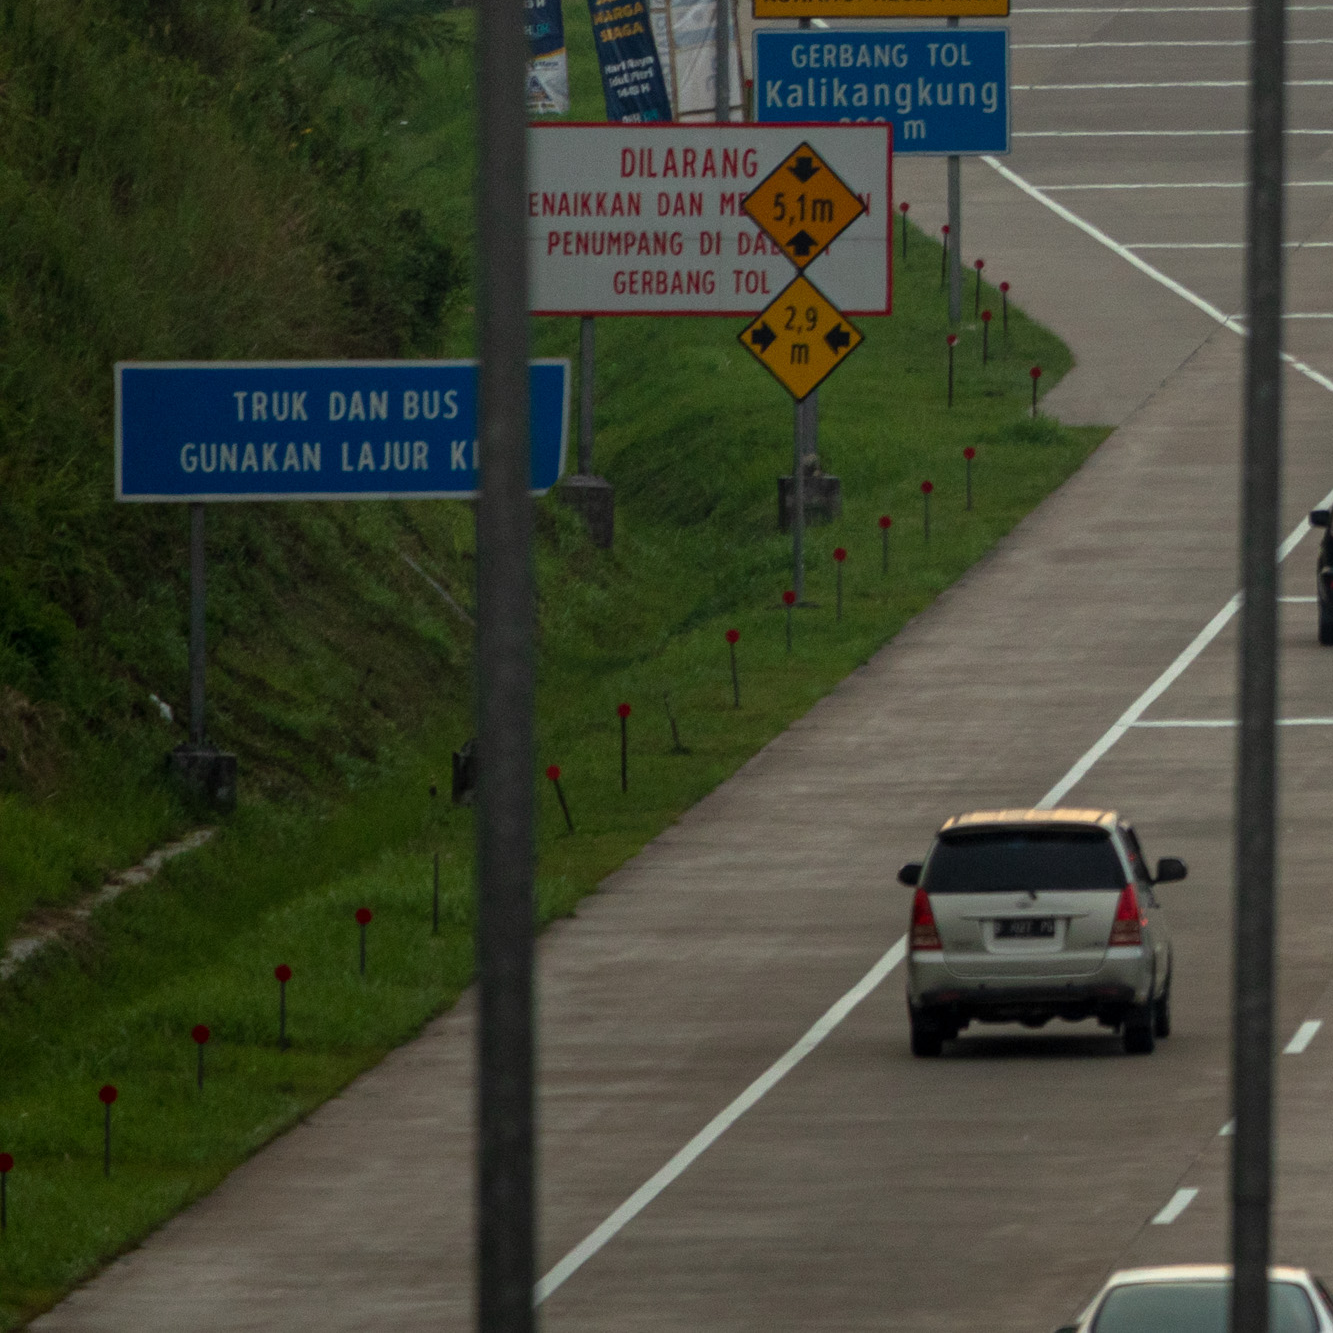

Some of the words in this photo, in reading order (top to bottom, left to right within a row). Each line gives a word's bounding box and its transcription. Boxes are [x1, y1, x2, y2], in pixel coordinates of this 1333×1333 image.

[600, 21, 645, 43] SIAGA
[791, 44, 908, 68] GERBANG
[927, 43, 971, 66] TOL
[766, 77, 998, 114] Kalikangkung
[904, 118, 926, 140] m
[620, 147, 759, 179] DILARANG
[529, 192, 641, 217] ENAIKKAN
[657, 192, 703, 217] DAN
[547, 231, 683, 256] PENUMPANG
[700, 231, 722, 256] DI
[613, 270, 716, 295] GERBANG
[733, 270, 771, 295] TOL
[784, 306, 819, 333] 2,9
[790, 342, 810, 365] m
[233, 391, 309, 421] TRUK
[328, 390, 389, 421] DAN
[403, 390, 459, 420] BUS
[180, 442, 322, 472] GUNAKAN
[341, 441, 429, 471] LAJUR
[450, 440, 480, 470] KI
